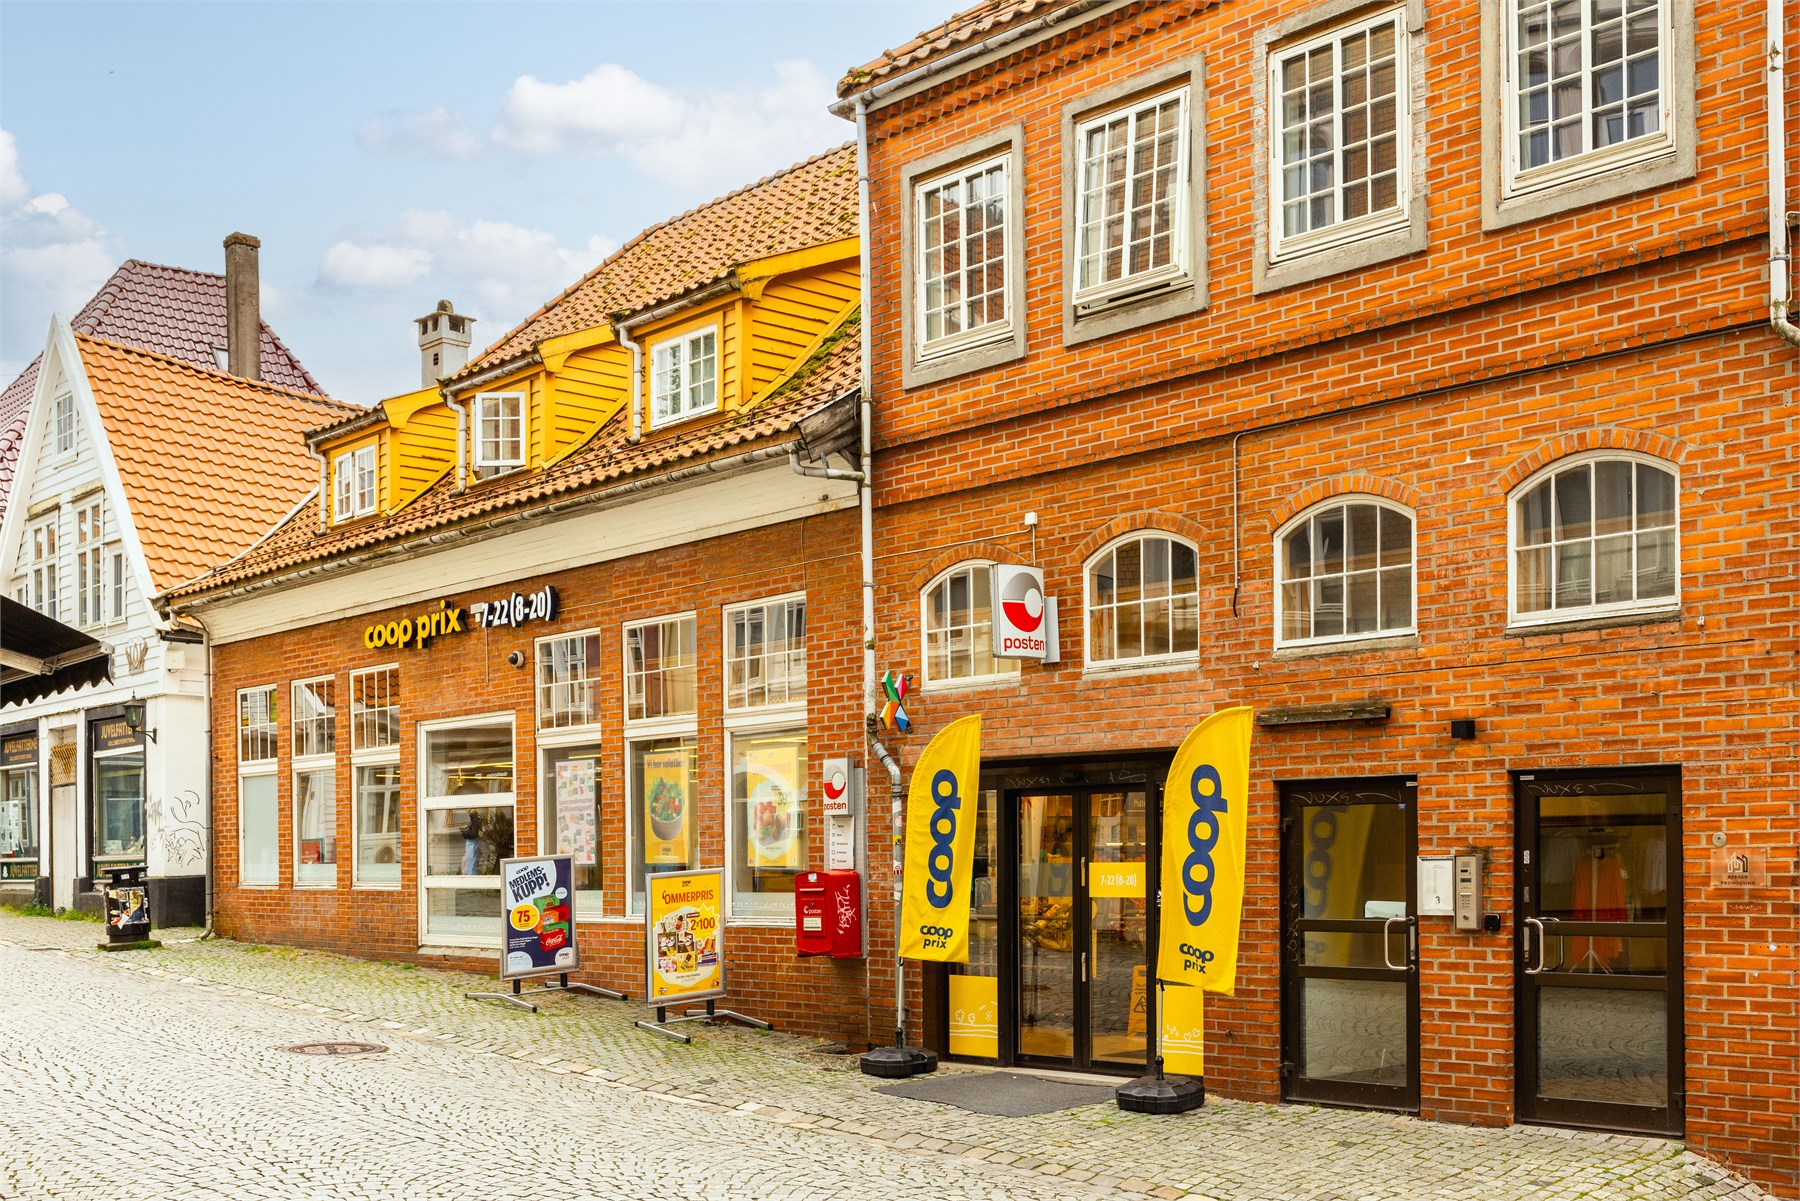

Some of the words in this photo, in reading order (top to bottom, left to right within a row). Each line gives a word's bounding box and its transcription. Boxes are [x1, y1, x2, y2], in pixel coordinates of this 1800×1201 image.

[364, 618, 412, 649] coop
[417, 599, 462, 649] prix
[1003, 635, 1045, 652] posten
[823, 801, 847, 811] posten
[926, 768, 962, 909] coop
[1181, 763, 1229, 927] coop
[508, 866, 545, 890] MEDLEMS-
[516, 865, 529, 875] coop
[511, 872, 551, 903] KUPP!
[516, 910, 531, 923] 75
[698, 917, 716, 930] 100
[919, 924, 954, 940] coop
[922, 936, 948, 949] prix
[1178, 942, 1215, 964] coop
[1183, 958, 1207, 975] prix
